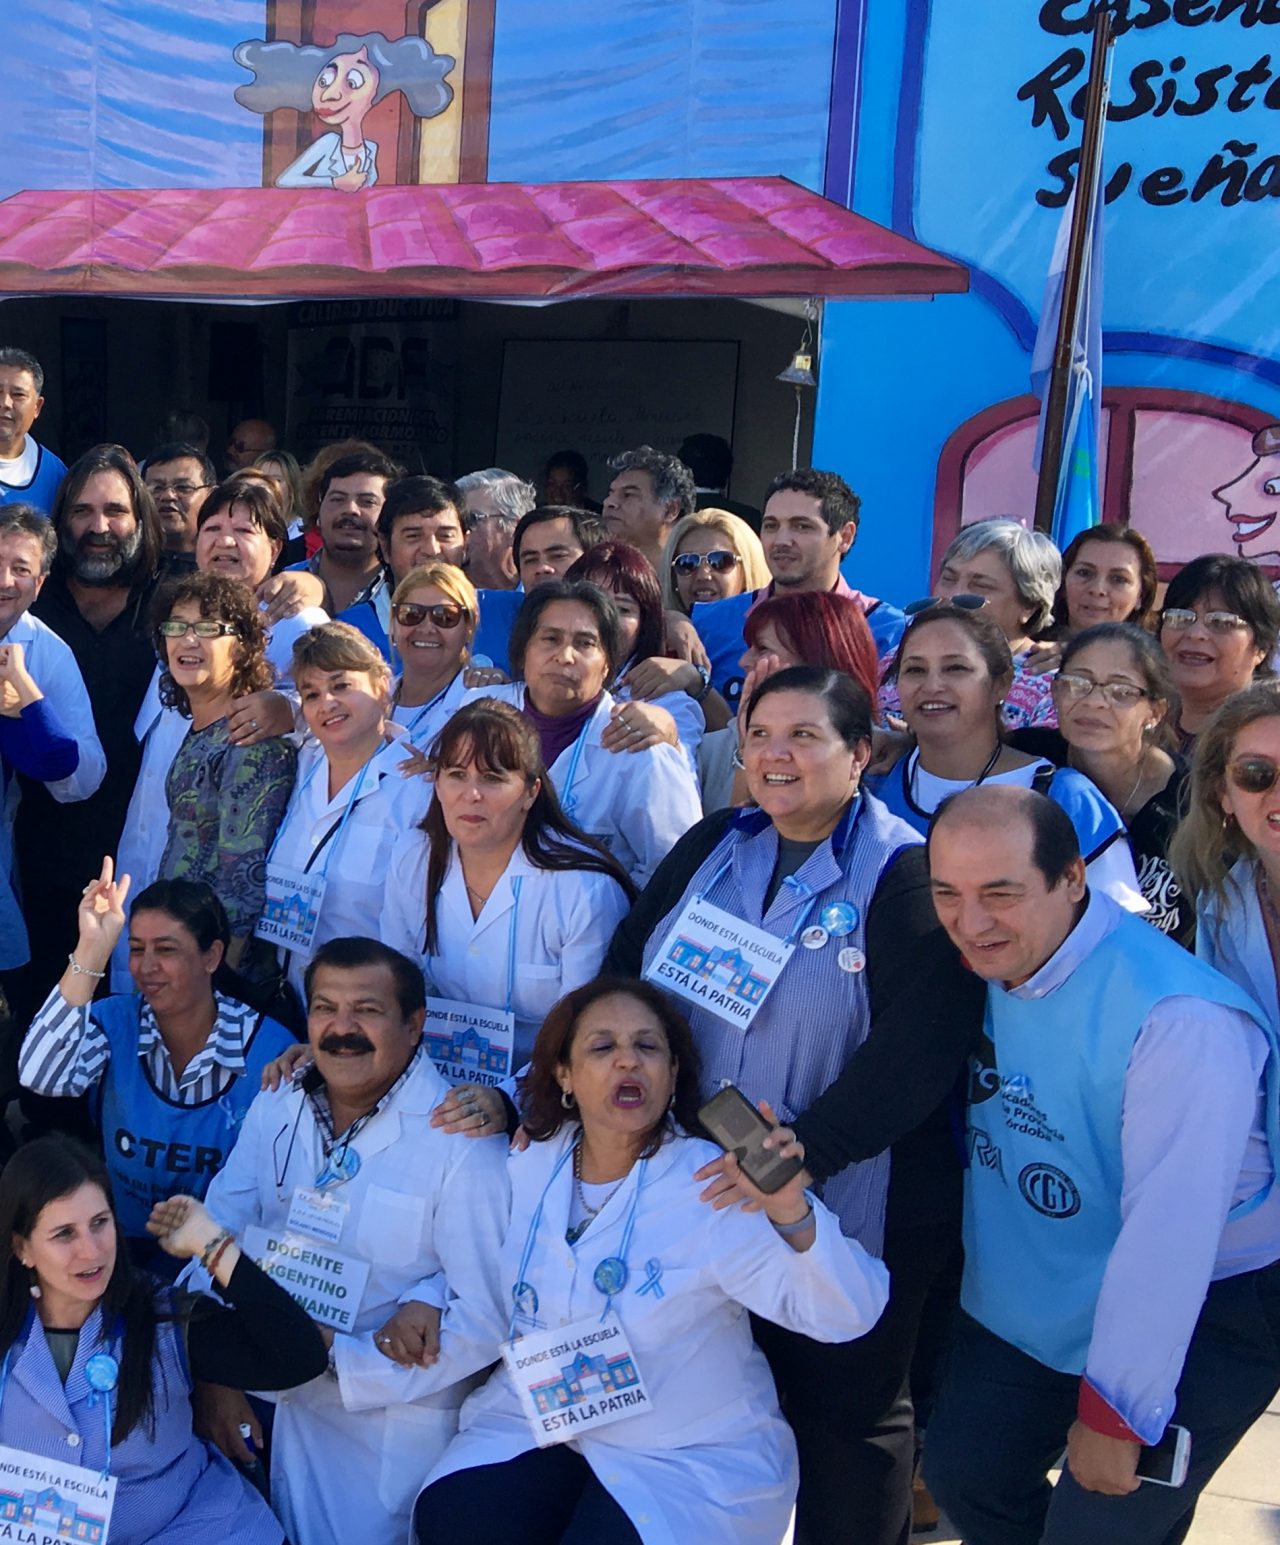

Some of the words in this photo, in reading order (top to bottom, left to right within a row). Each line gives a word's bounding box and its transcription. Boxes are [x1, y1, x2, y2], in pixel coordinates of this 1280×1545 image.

[258, 919, 280, 935] ESTÁ
[289, 930, 311, 947] PATRIA
[688, 911, 720, 937] DONDE
[718, 926, 739, 945] ESTÁ
[737, 937, 749, 950] LA
[747, 941, 783, 966] ESCUELA
[657, 961, 691, 989] ESTÁ
[690, 978, 707, 998] LA
[708, 990, 752, 1021] PATRIA
[449, 1012, 468, 1023] ESTÁ
[468, 1017, 478, 1026] LA
[479, 1018, 510, 1033] ESCUELA
[451, 1066, 467, 1081] LA
[115, 1128, 223, 1174] CTER
[266, 1239, 345, 1275] DOCENTE
[255, 1257, 348, 1300] ARGENTINO
[516, 1350, 550, 1370] DONDE
[550, 1341, 571, 1358] ESTÁ
[570, 1338, 584, 1351] LA
[583, 1326, 621, 1347] ESCUELA
[541, 1407, 579, 1433] ESTÁ
[579, 1403, 600, 1422] LA
[600, 1388, 647, 1415] PATRIA
[22, 1467, 47, 1482] ESTÁ
[49, 1476, 62, 1486] LA
[63, 1479, 109, 1500] ESCUELA
[16, 1528, 38, 1545] LA
